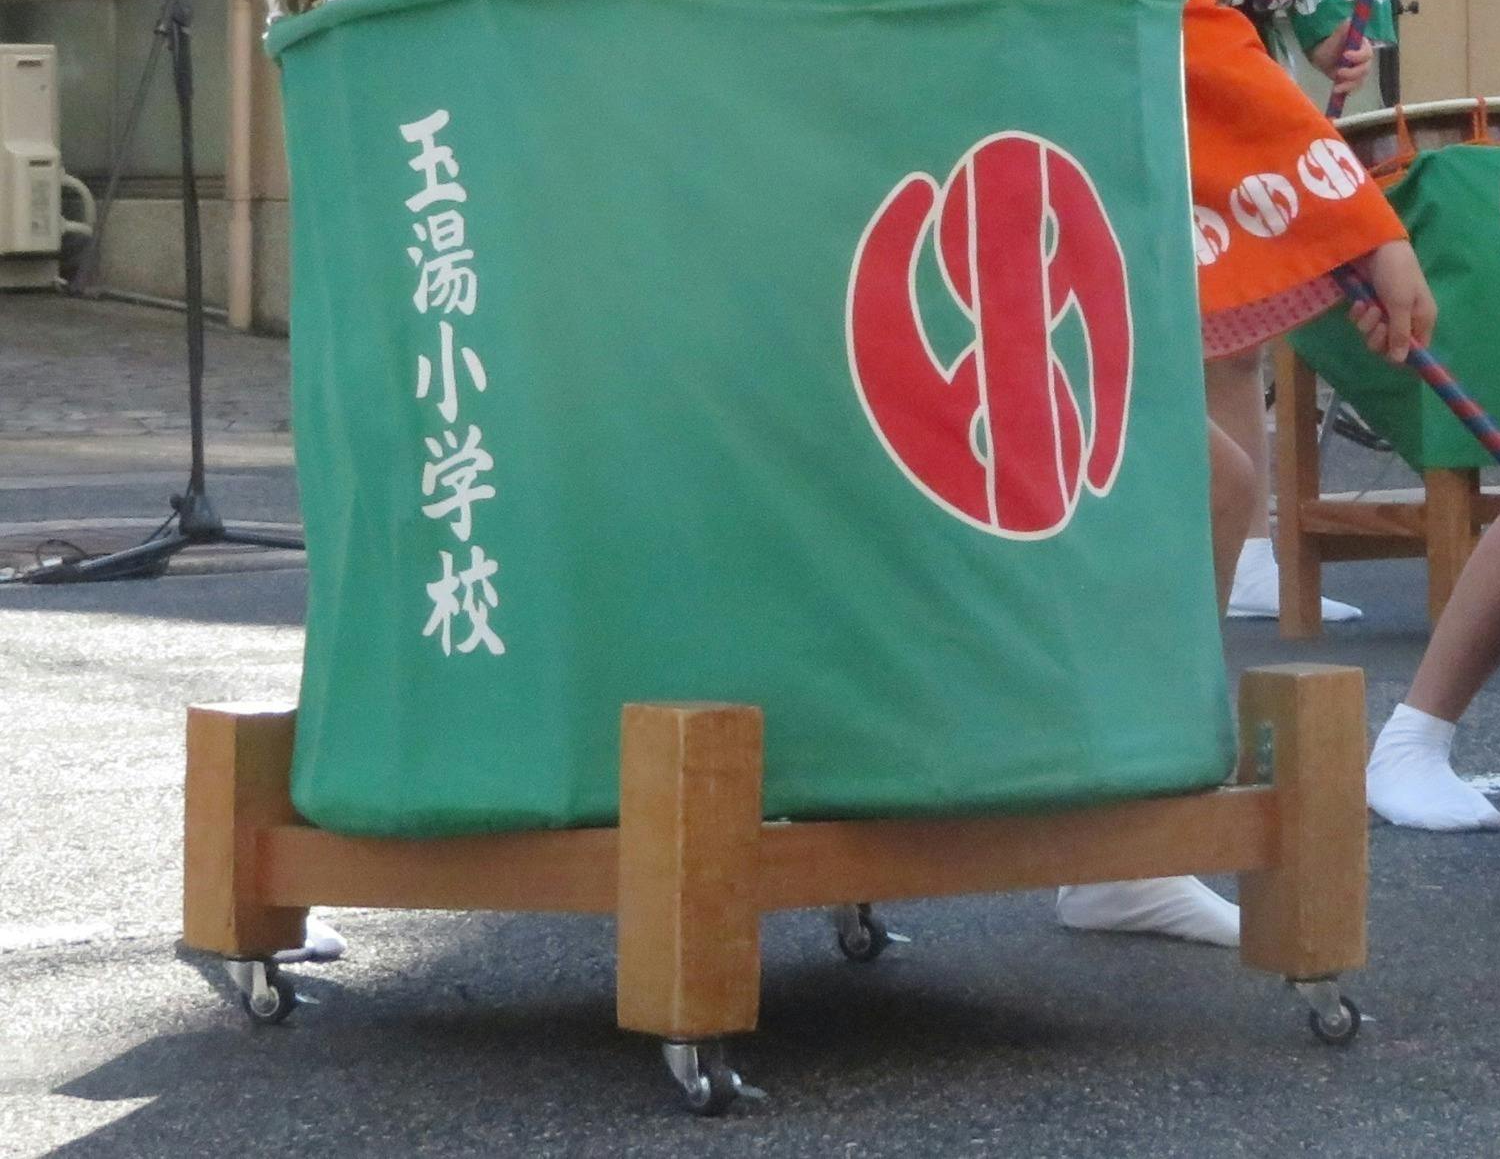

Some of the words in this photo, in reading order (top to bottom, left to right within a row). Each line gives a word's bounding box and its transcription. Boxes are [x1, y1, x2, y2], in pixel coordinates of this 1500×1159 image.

[399, 109, 506, 657] 玉湯小学校
